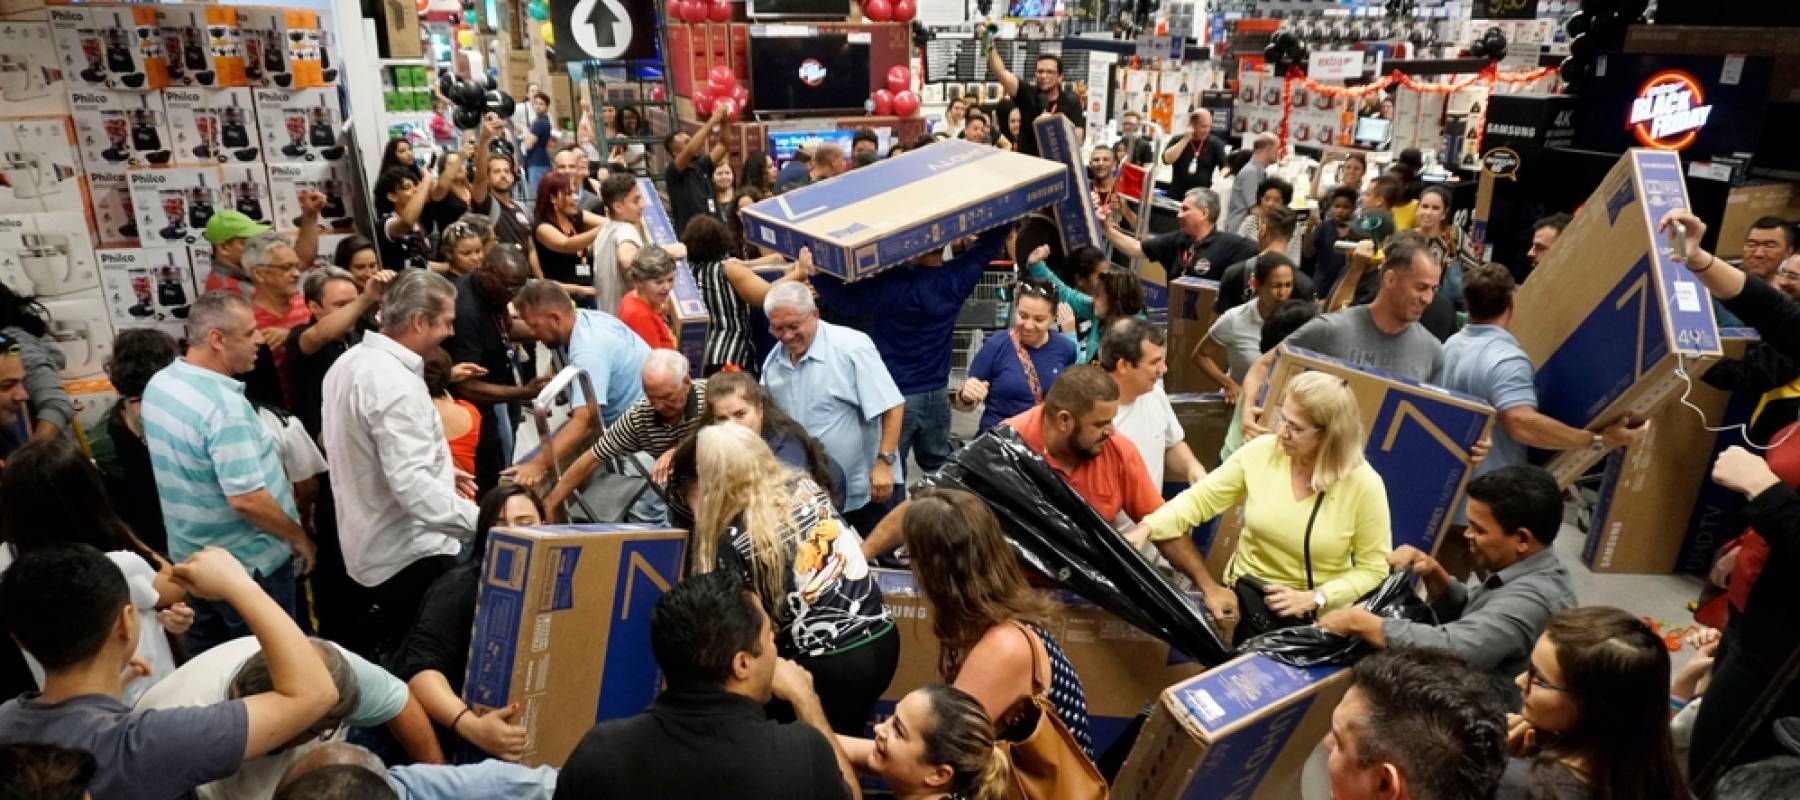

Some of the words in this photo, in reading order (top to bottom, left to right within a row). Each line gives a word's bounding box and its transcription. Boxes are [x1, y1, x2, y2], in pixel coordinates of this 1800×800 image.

[51, 10, 84, 20] Philco
[72, 93, 108, 103] Philco
[166, 92, 200, 101] Philco
[257, 91, 290, 101] Philco
[1631, 89, 1692, 123] BLACK
[1554, 109, 1574, 127] 4K
[1651, 105, 1712, 139] FRIDAY
[1486, 122, 1536, 137] SAMSUNG
[271, 166, 301, 175] Philco
[131, 174, 166, 183] Philco
[101, 253, 135, 263] Philco
[1601, 521, 1623, 568] SAMSUNG
